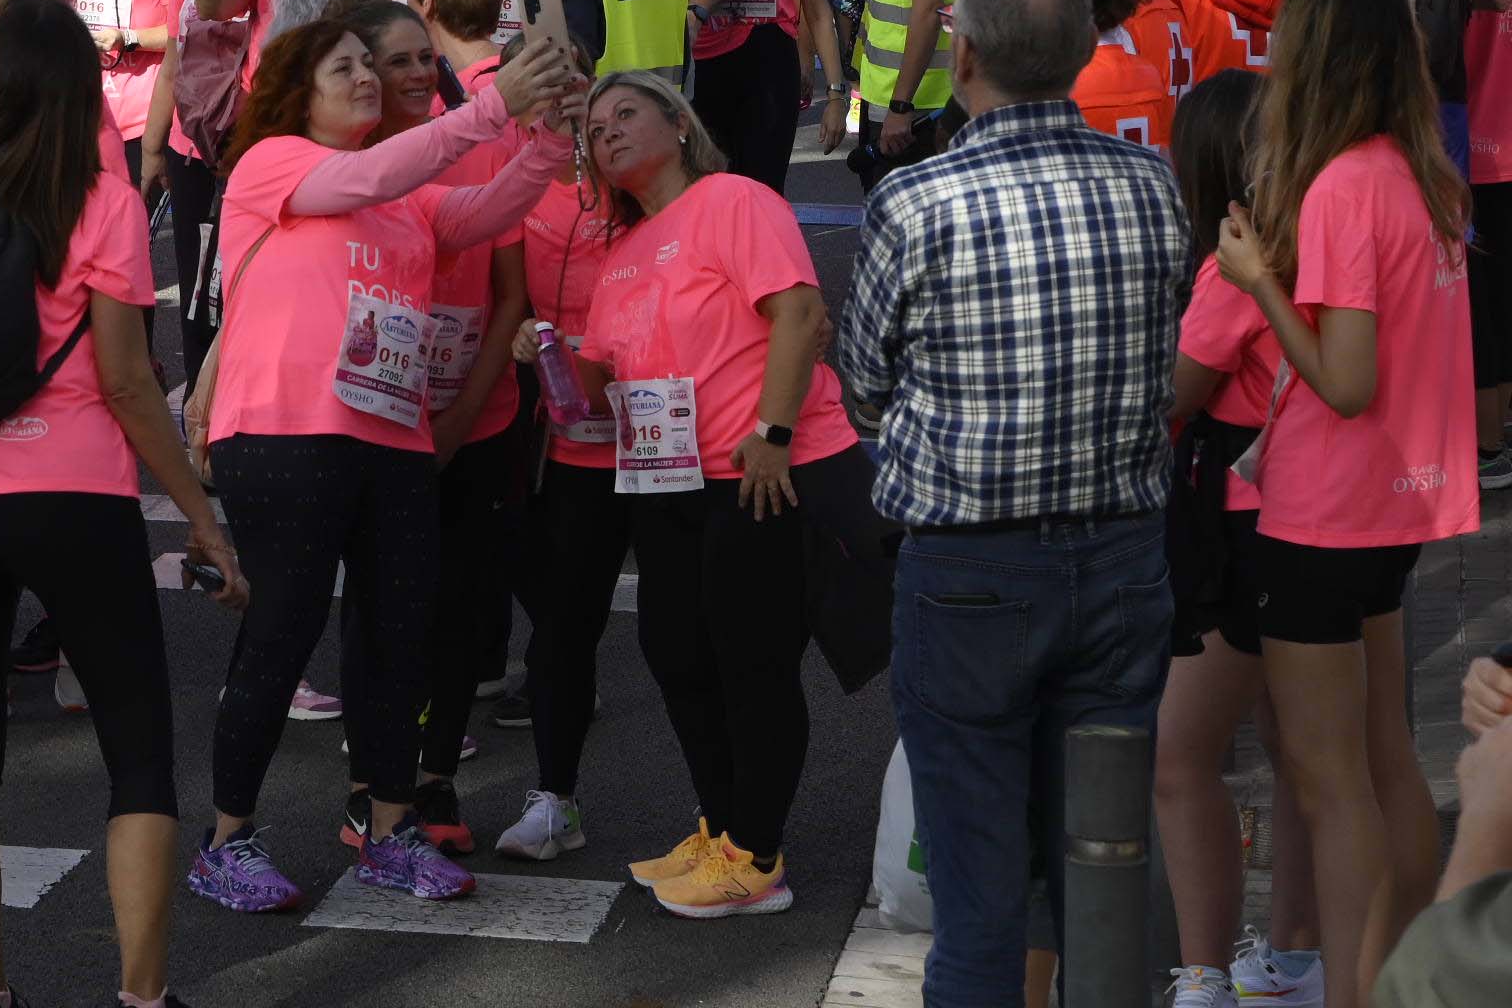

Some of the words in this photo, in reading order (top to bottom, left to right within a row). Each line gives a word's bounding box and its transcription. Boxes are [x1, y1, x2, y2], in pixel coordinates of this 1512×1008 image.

[79, 0, 104, 13] 016
[346, 242, 380, 270] TU
[379, 347, 410, 370] 016
[430, 346, 453, 362] 16
[377, 367, 404, 384] 27092
[340, 388, 374, 405] OYSHO
[660, 475, 694, 483] Santander
[1393, 473, 1447, 493] OYSHO
